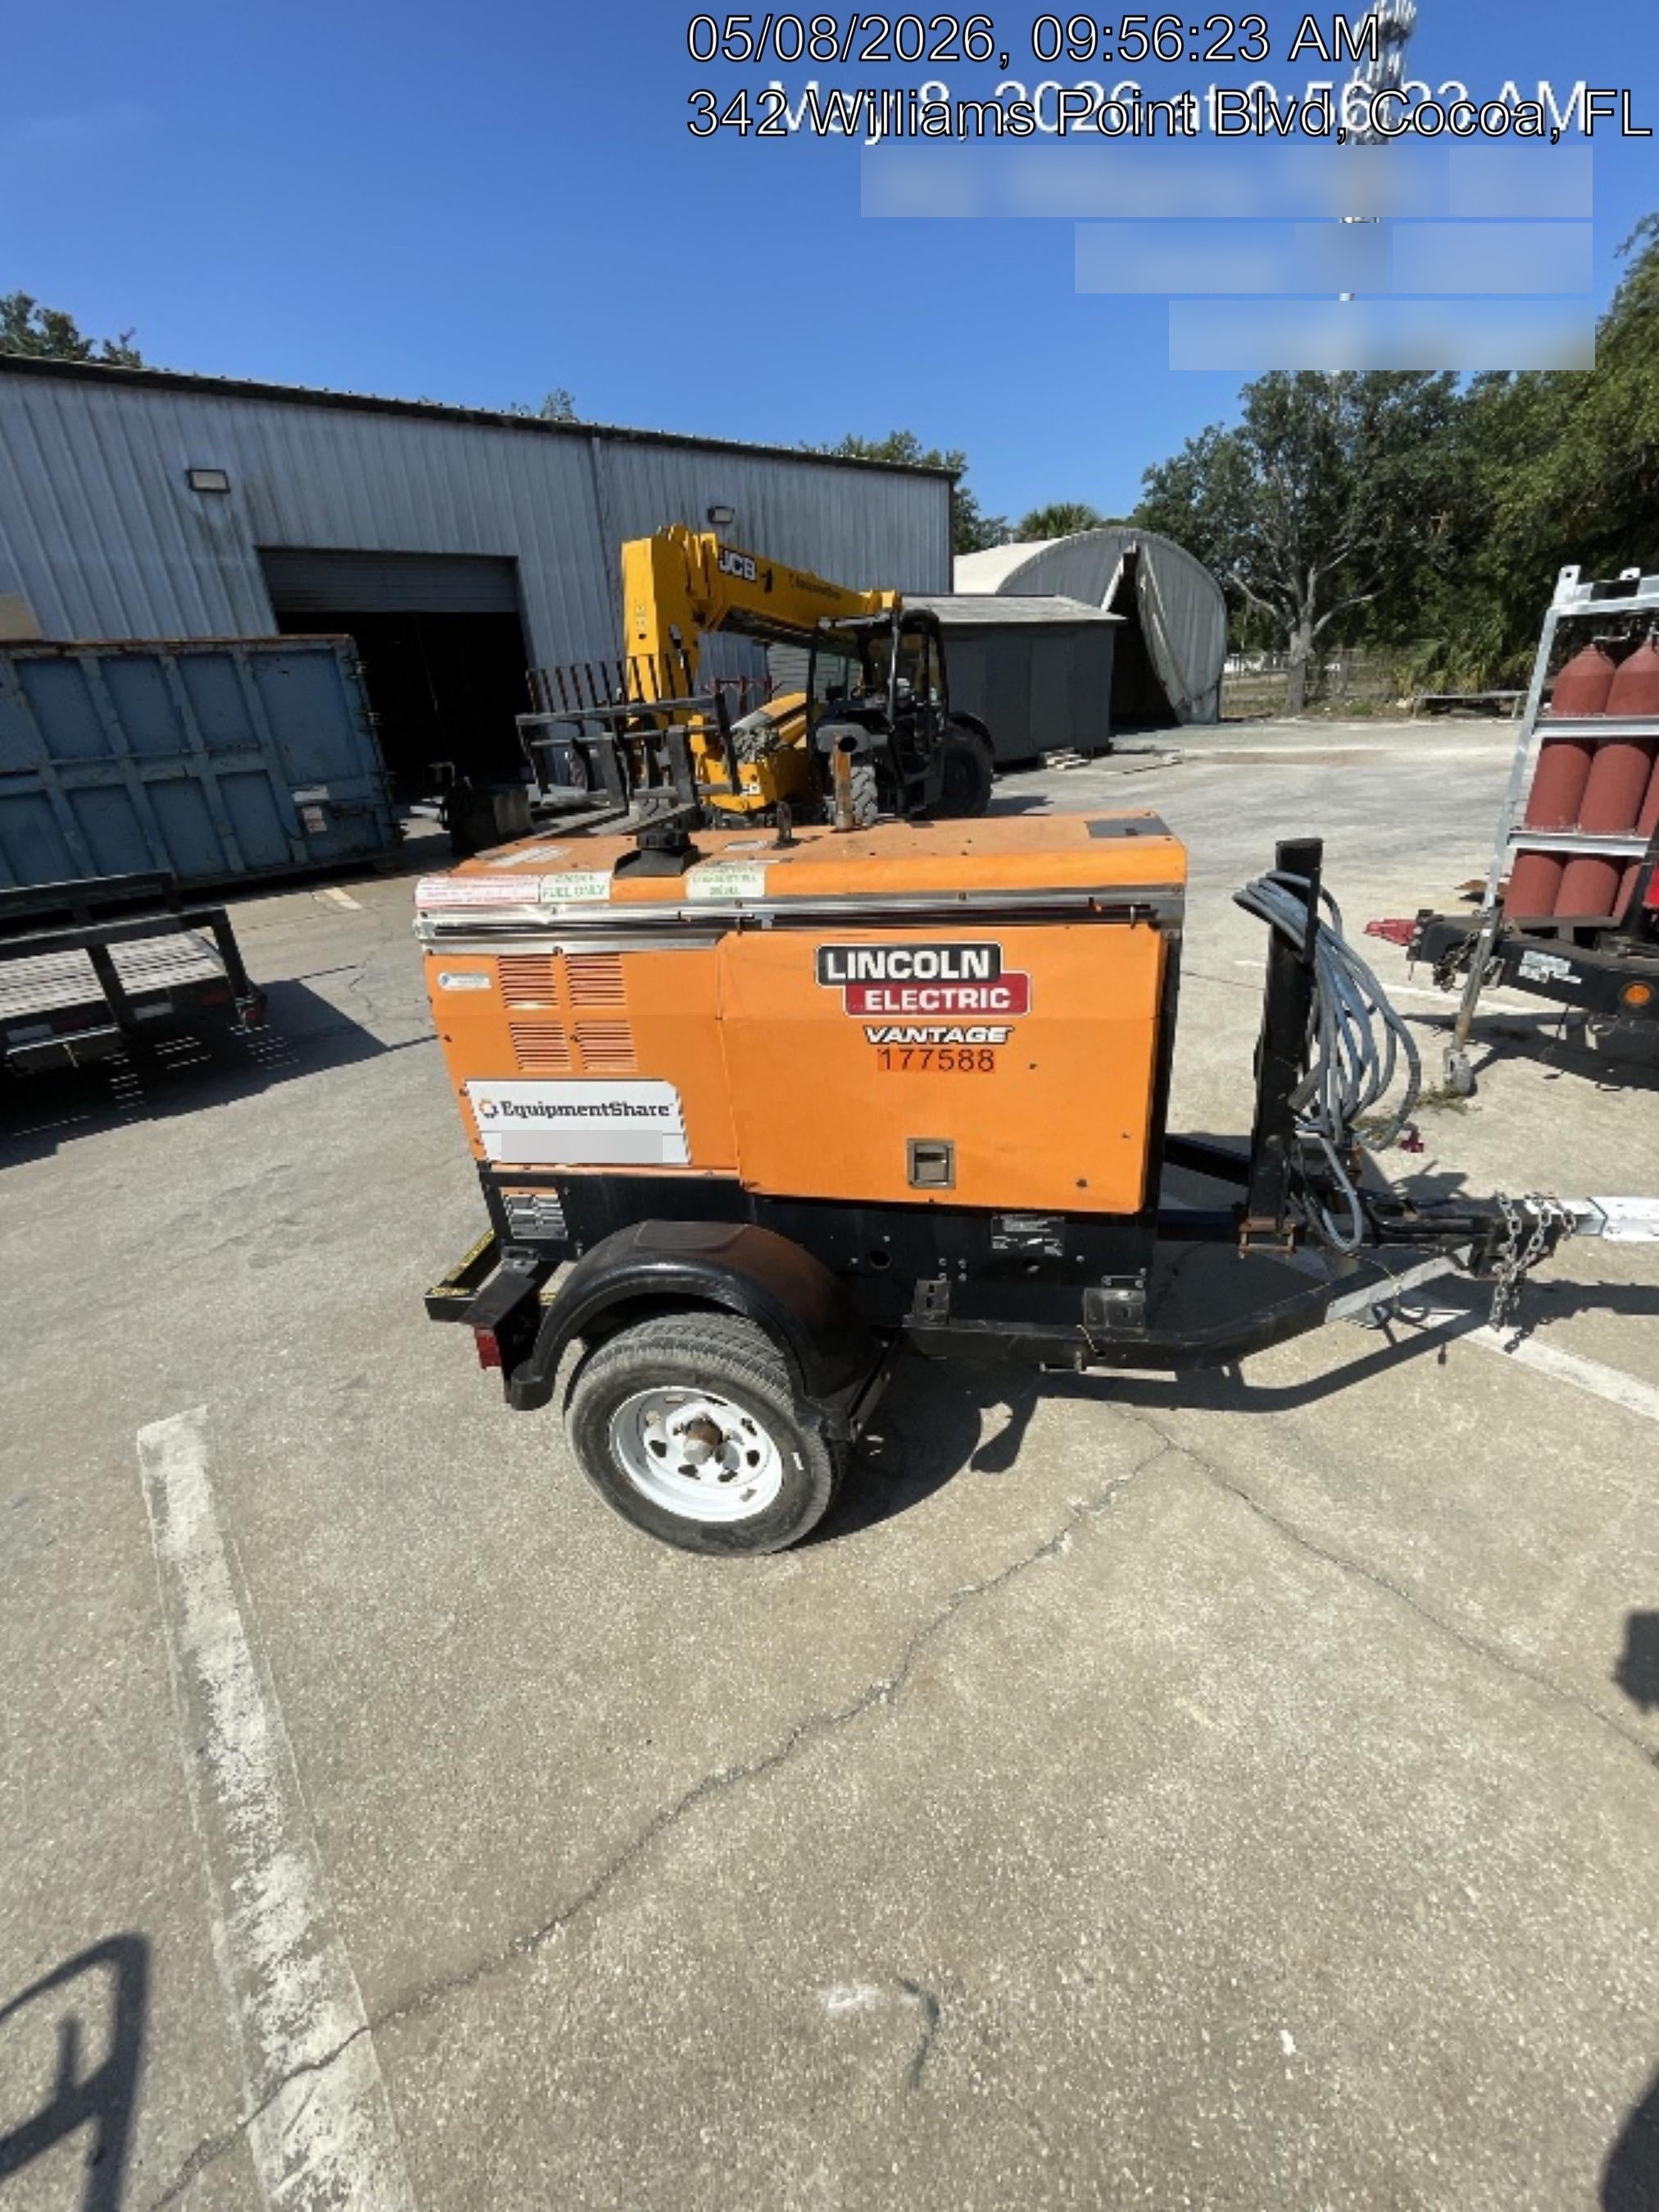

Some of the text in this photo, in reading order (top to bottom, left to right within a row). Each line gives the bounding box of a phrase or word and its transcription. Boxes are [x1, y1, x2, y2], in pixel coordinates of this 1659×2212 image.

[719, 550, 756, 582] JCB
[827, 950, 990, 980] LINCOLN
[863, 986, 1012, 1012] ELECTRIC
[864, 1026, 1013, 1044] VANTAGE
[878, 1048, 995, 1072] 177588
[499, 1100, 671, 1119] EquipmentShare
